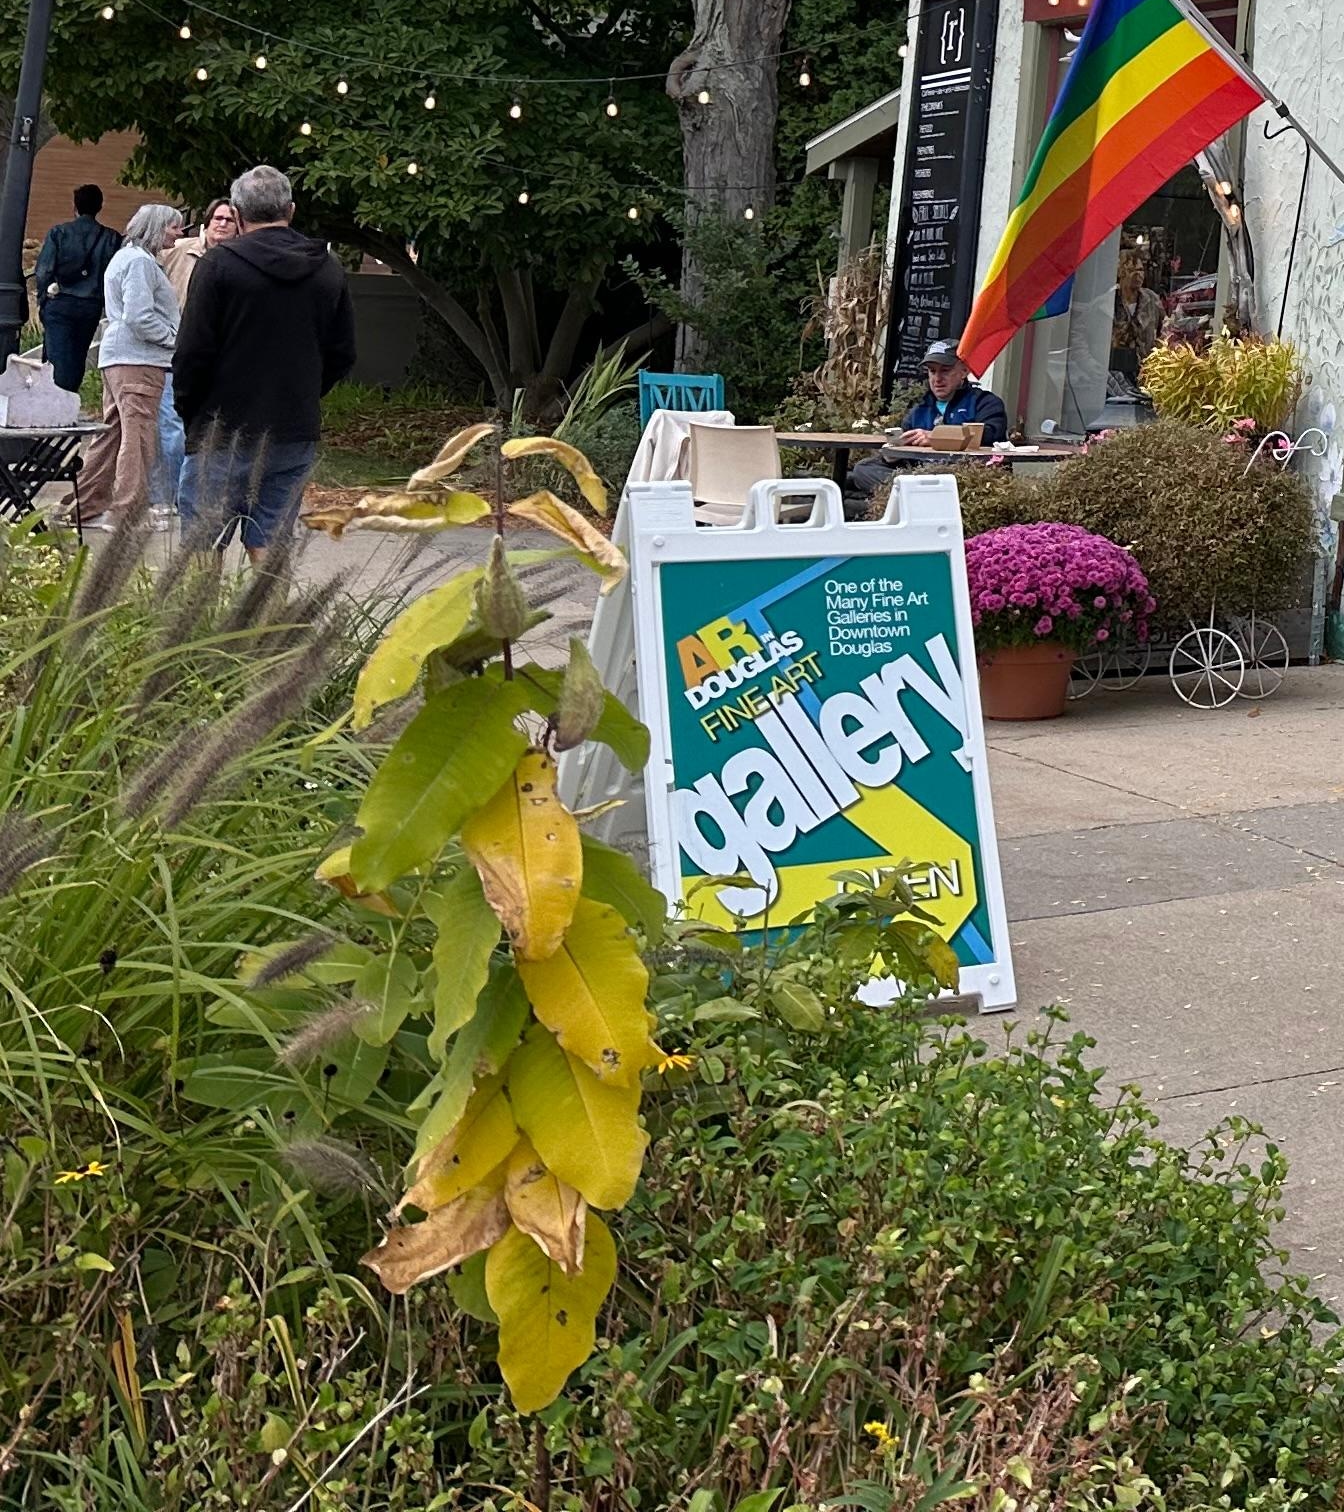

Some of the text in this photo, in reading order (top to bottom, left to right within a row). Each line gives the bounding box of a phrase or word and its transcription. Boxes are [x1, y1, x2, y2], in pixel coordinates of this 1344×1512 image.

[824, 577, 903, 595] One of the
[826, 590, 929, 613] Many Fine Art
[827, 608, 908, 626] Galleries in
[759, 629, 777, 645] IN
[828, 623, 910, 640] Downtown
[676, 606, 778, 690] ART
[830, 639, 893, 658] Douglas
[683, 630, 804, 711] DOUGLAS
[699, 650, 825, 742] FINE ART
[673, 633, 973, 918] gallery
